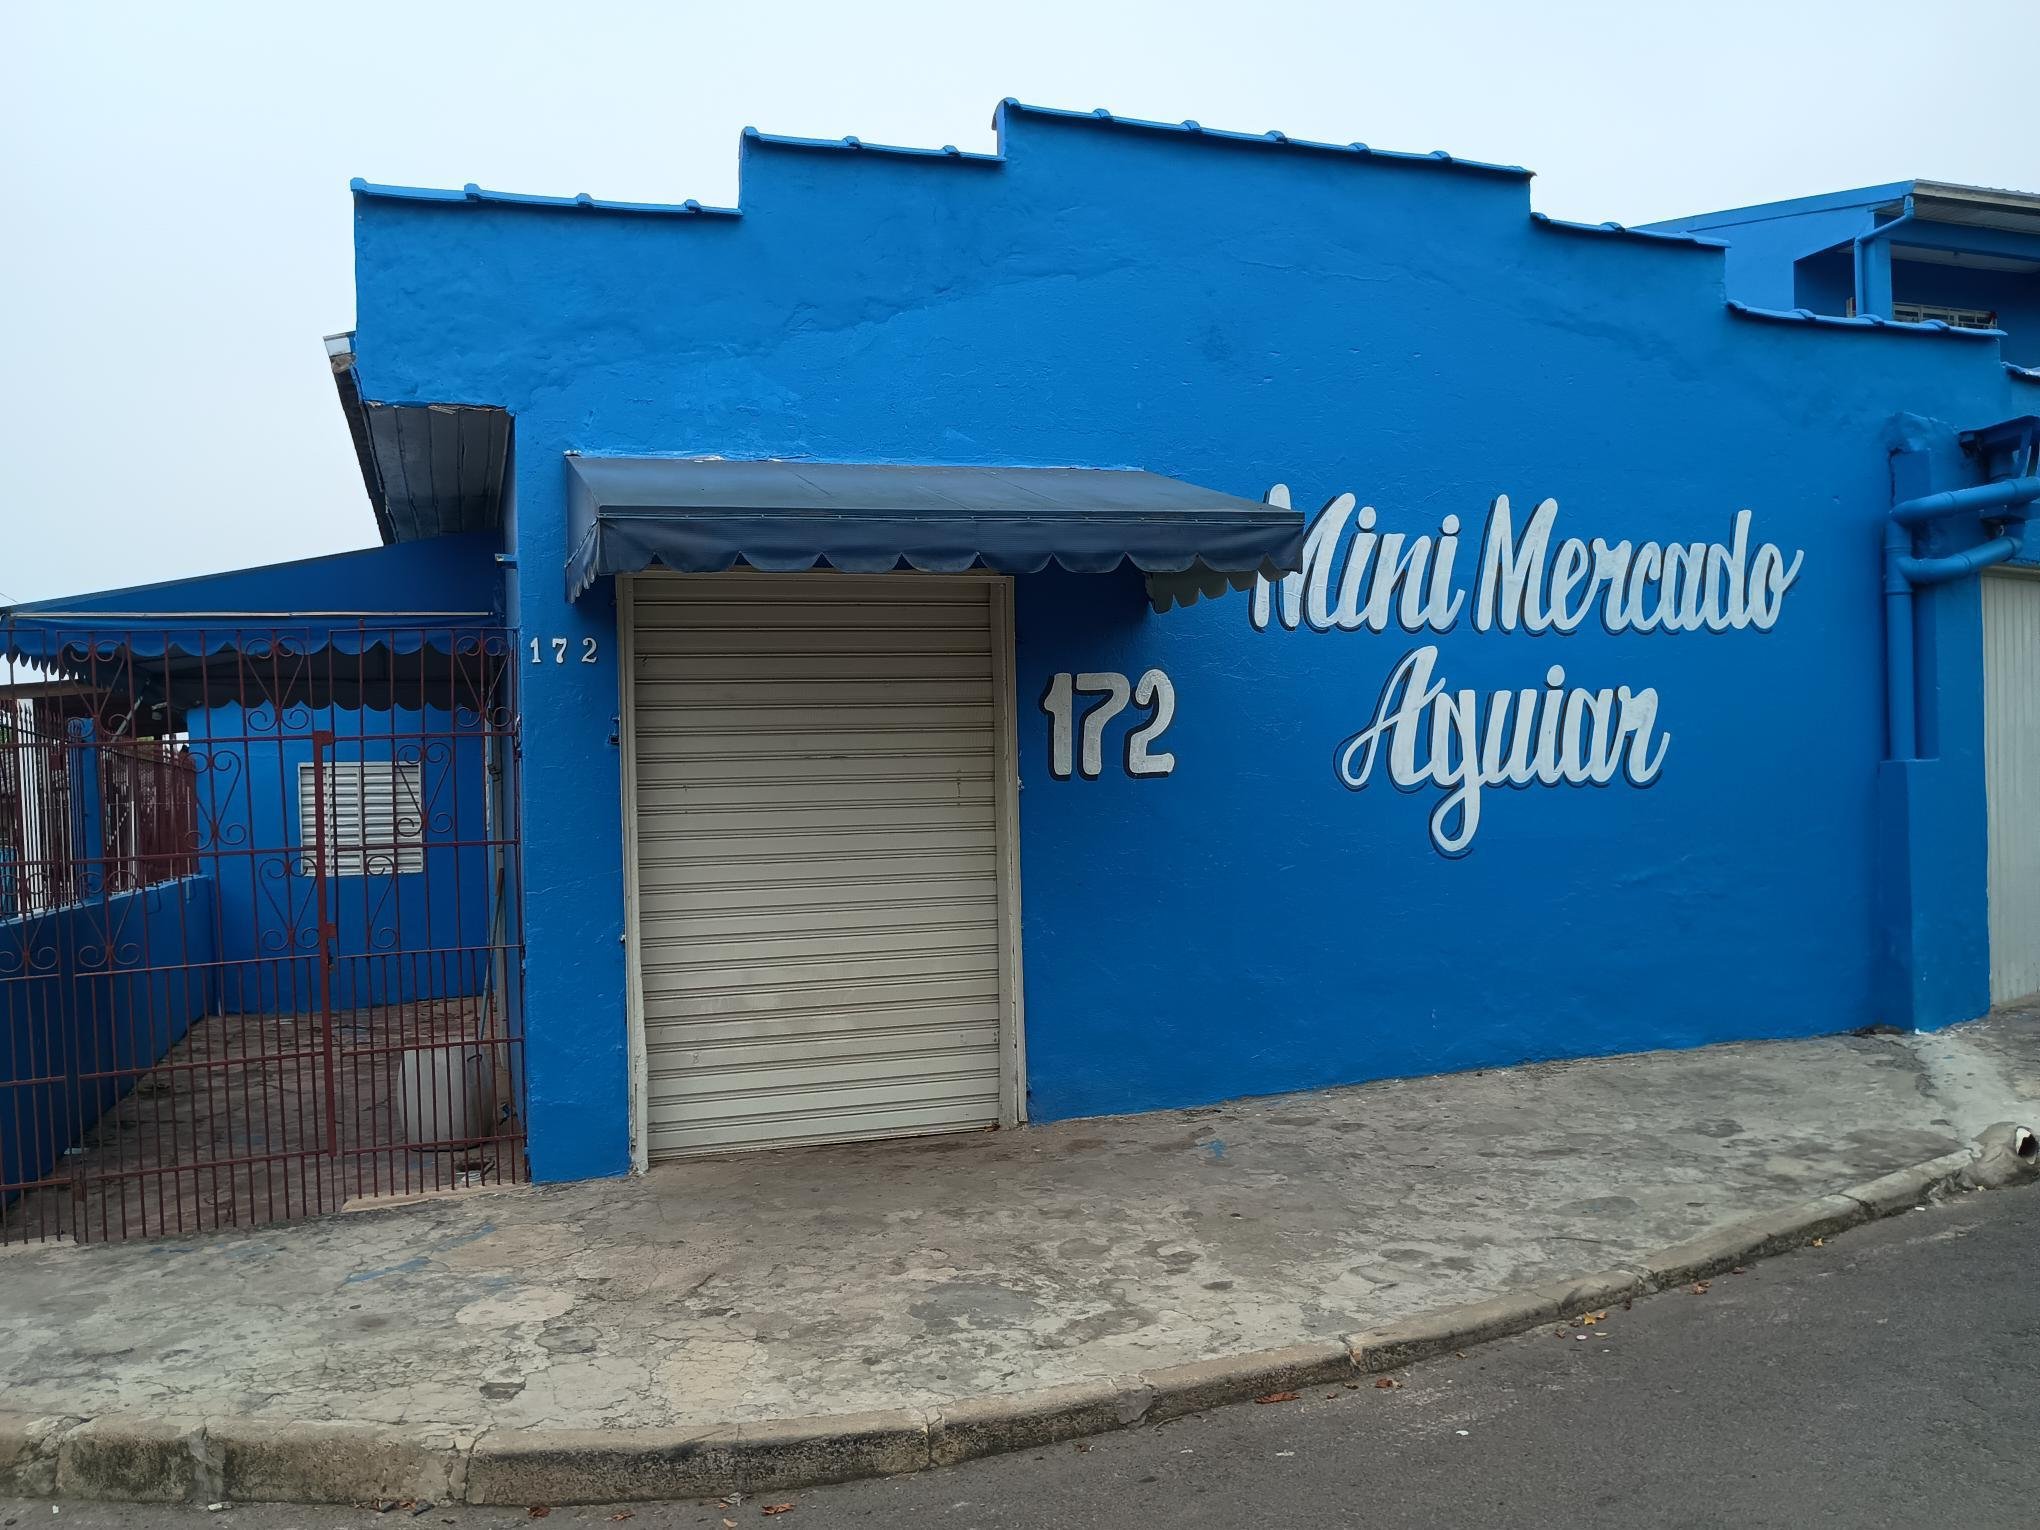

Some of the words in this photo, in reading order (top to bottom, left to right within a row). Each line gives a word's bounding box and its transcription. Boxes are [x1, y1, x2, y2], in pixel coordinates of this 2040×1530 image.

[1251, 483, 1465, 633] Mini
[1473, 494, 1804, 635] Mercado
[530, 636, 598, 665] 172
[1042, 668, 1176, 780] 172
[1336, 645, 1670, 858] Aguiar
